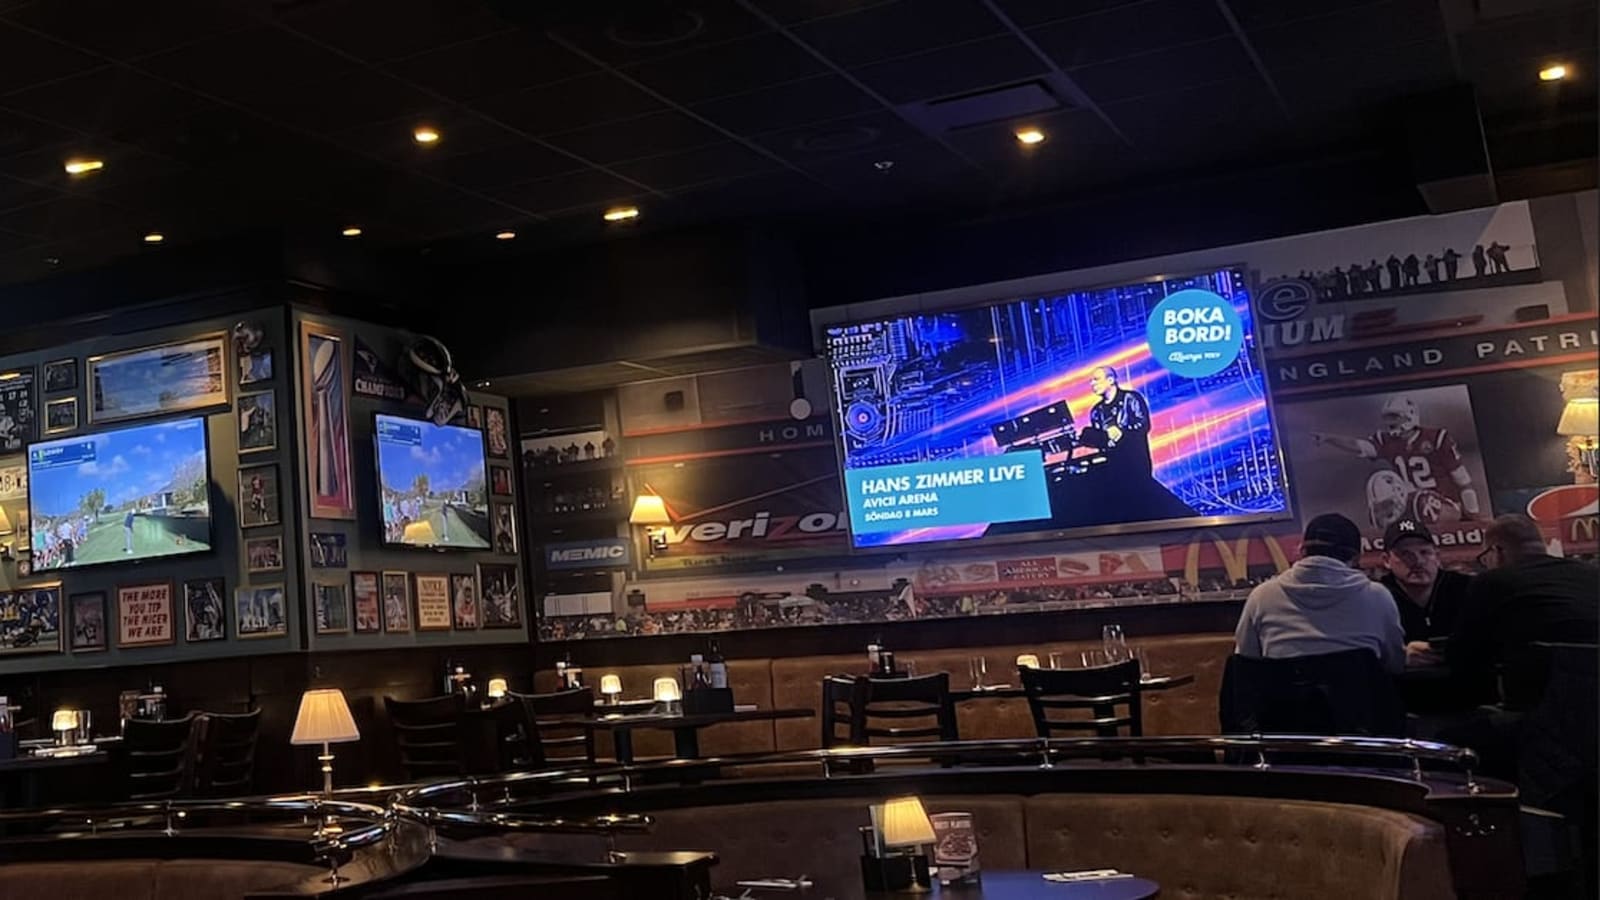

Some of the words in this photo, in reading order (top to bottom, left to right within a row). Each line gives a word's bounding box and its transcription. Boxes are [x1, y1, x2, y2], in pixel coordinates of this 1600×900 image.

[1164, 306, 1225, 326] BOKA
[1165, 324, 1231, 345] BORD!
[1476, 330, 1598, 359] PATRI
[760, 424, 823, 442] HOM
[862, 475, 910, 495] HANS
[915, 468, 984, 489] ZIMMER
[989, 465, 1025, 482] LIVE
[863, 496, 896, 509] AVICII
[898, 492, 938, 505] ARENA
[913, 508, 938, 518] MARS
[550, 545, 625, 563] MEMIC
[122, 592, 139, 602] THE
[141, 589, 167, 600] MORE
[129, 603, 146, 615] YOU
[147, 602, 161, 612] TIP
[123, 616, 140, 626] THE
[141, 612, 168, 624] NICER
[128, 626, 143, 638] WE
[145, 625, 163, 636] ARE
